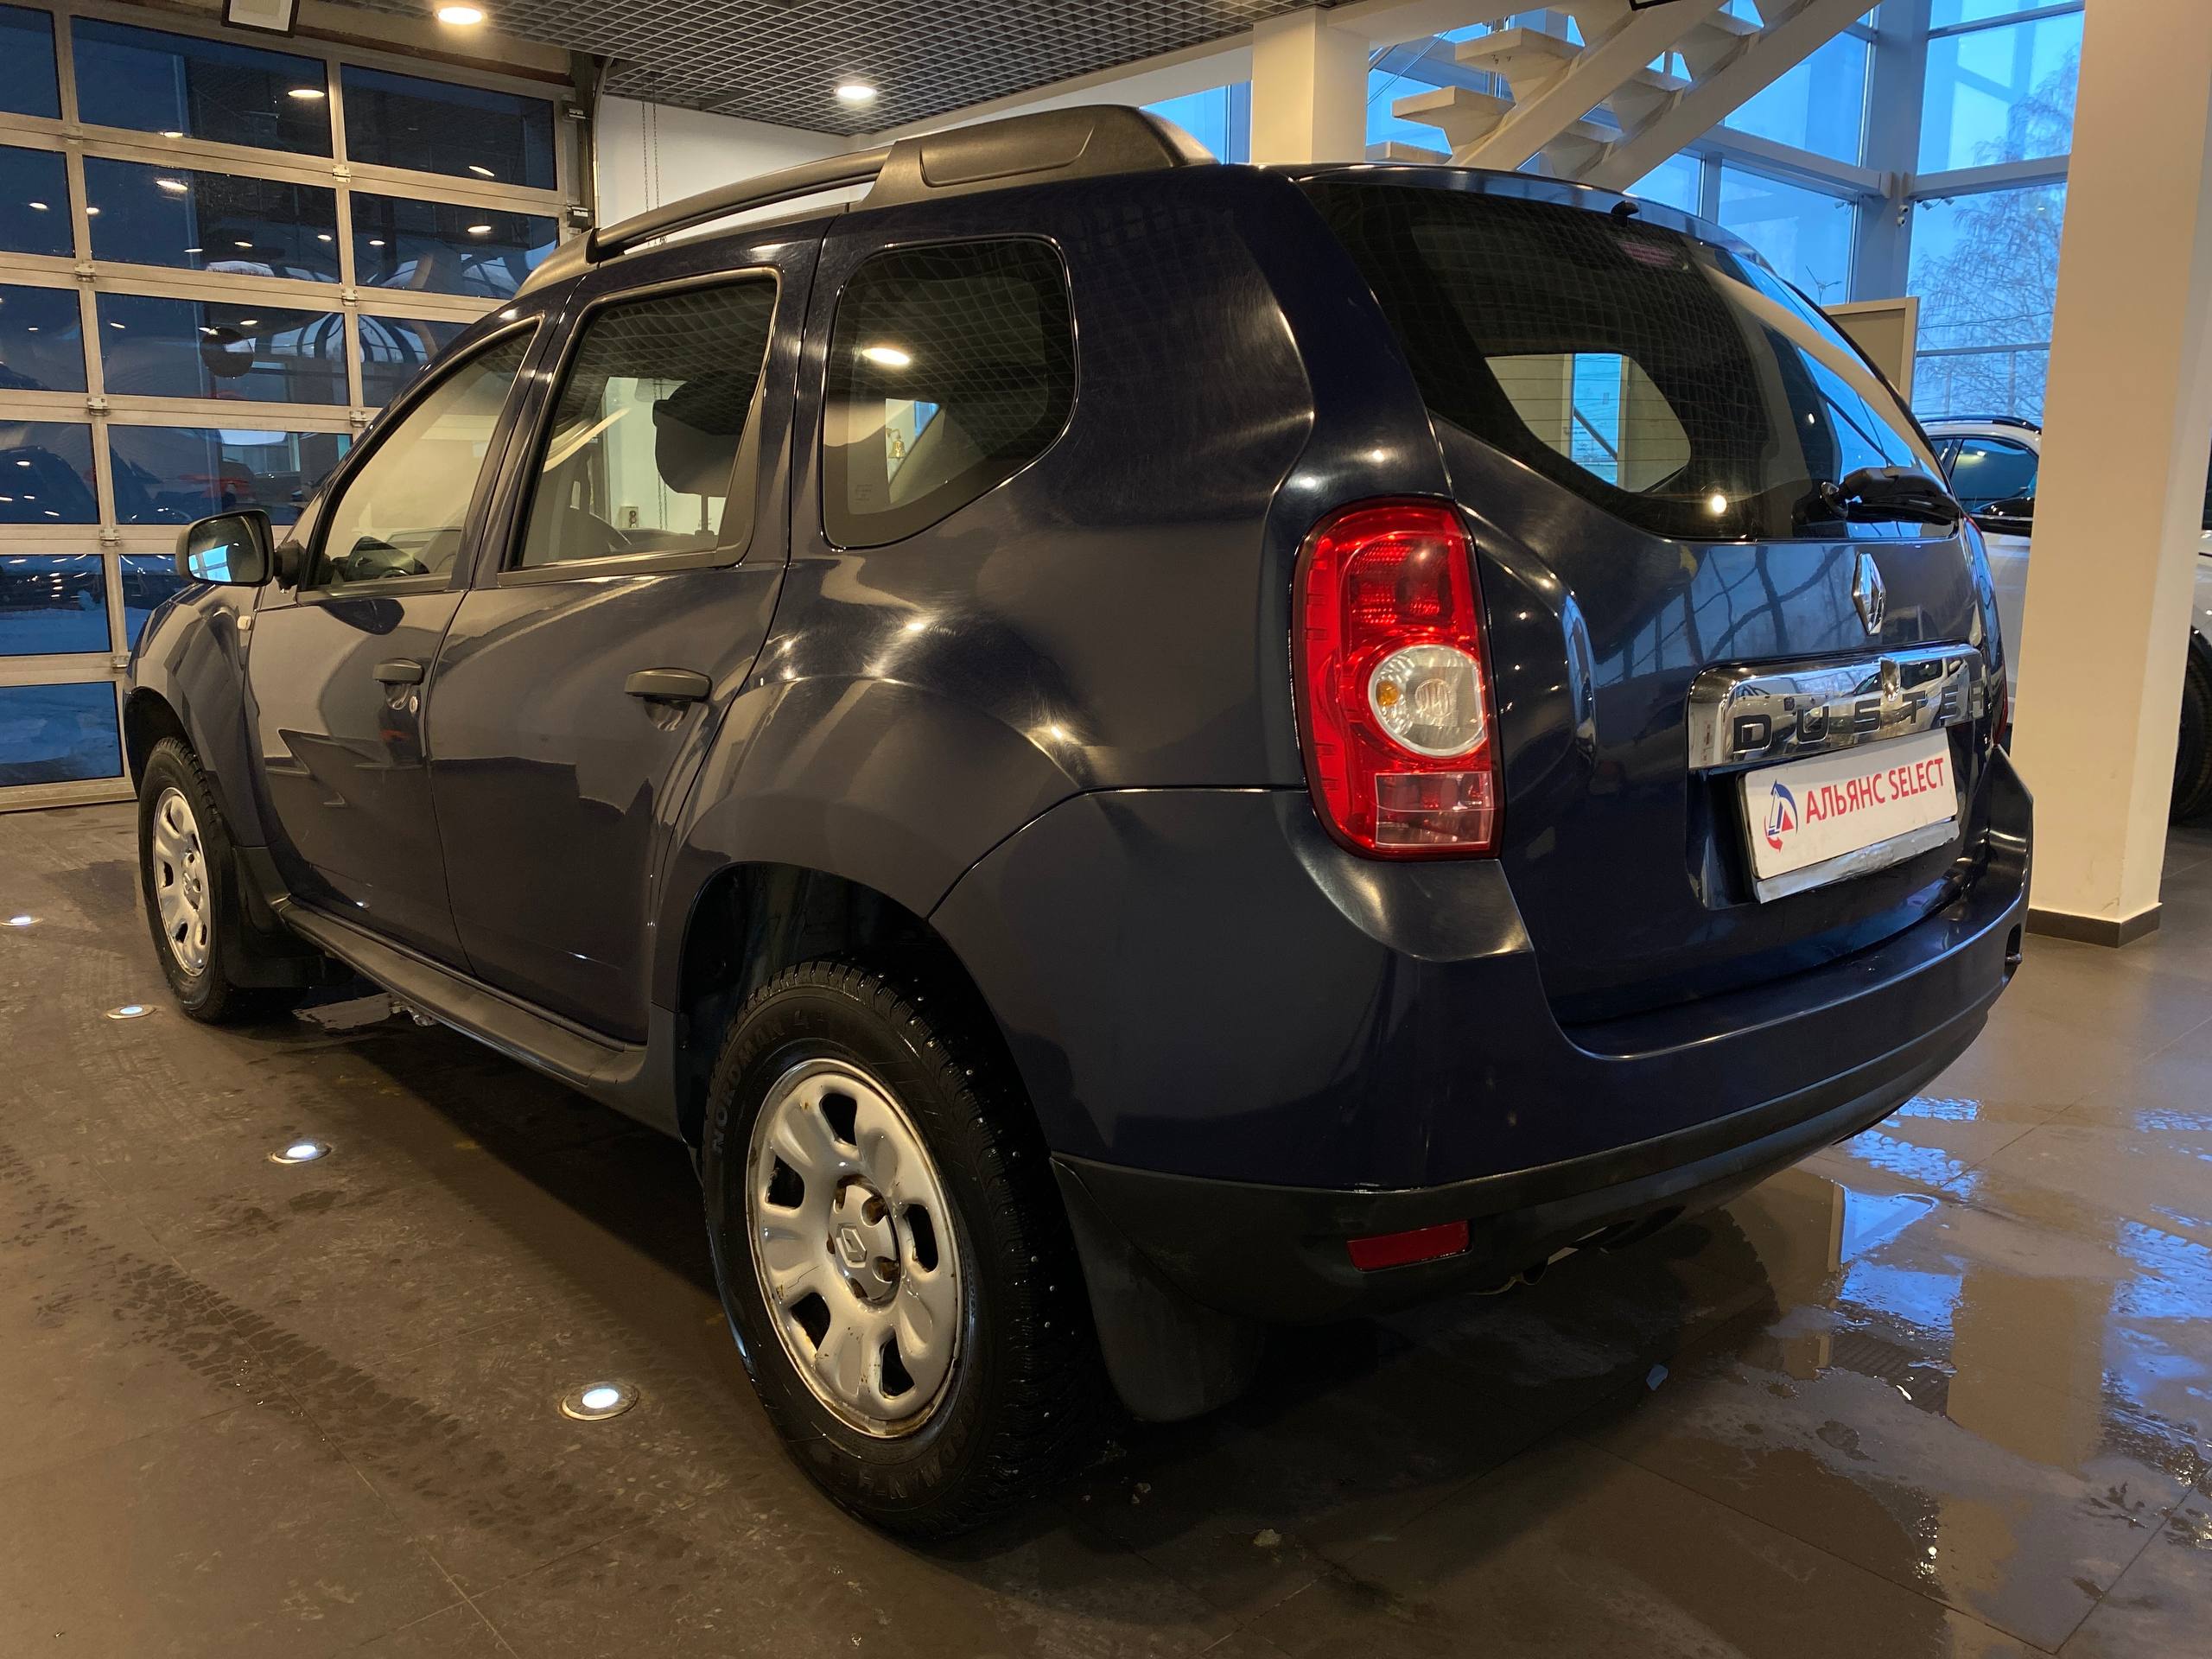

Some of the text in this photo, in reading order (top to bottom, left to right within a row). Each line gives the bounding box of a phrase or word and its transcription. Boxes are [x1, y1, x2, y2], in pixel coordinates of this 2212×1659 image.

[1733, 683, 1985, 753] DUSTER
[1806, 758, 1943, 823] АЛЬЯНС SELECT
